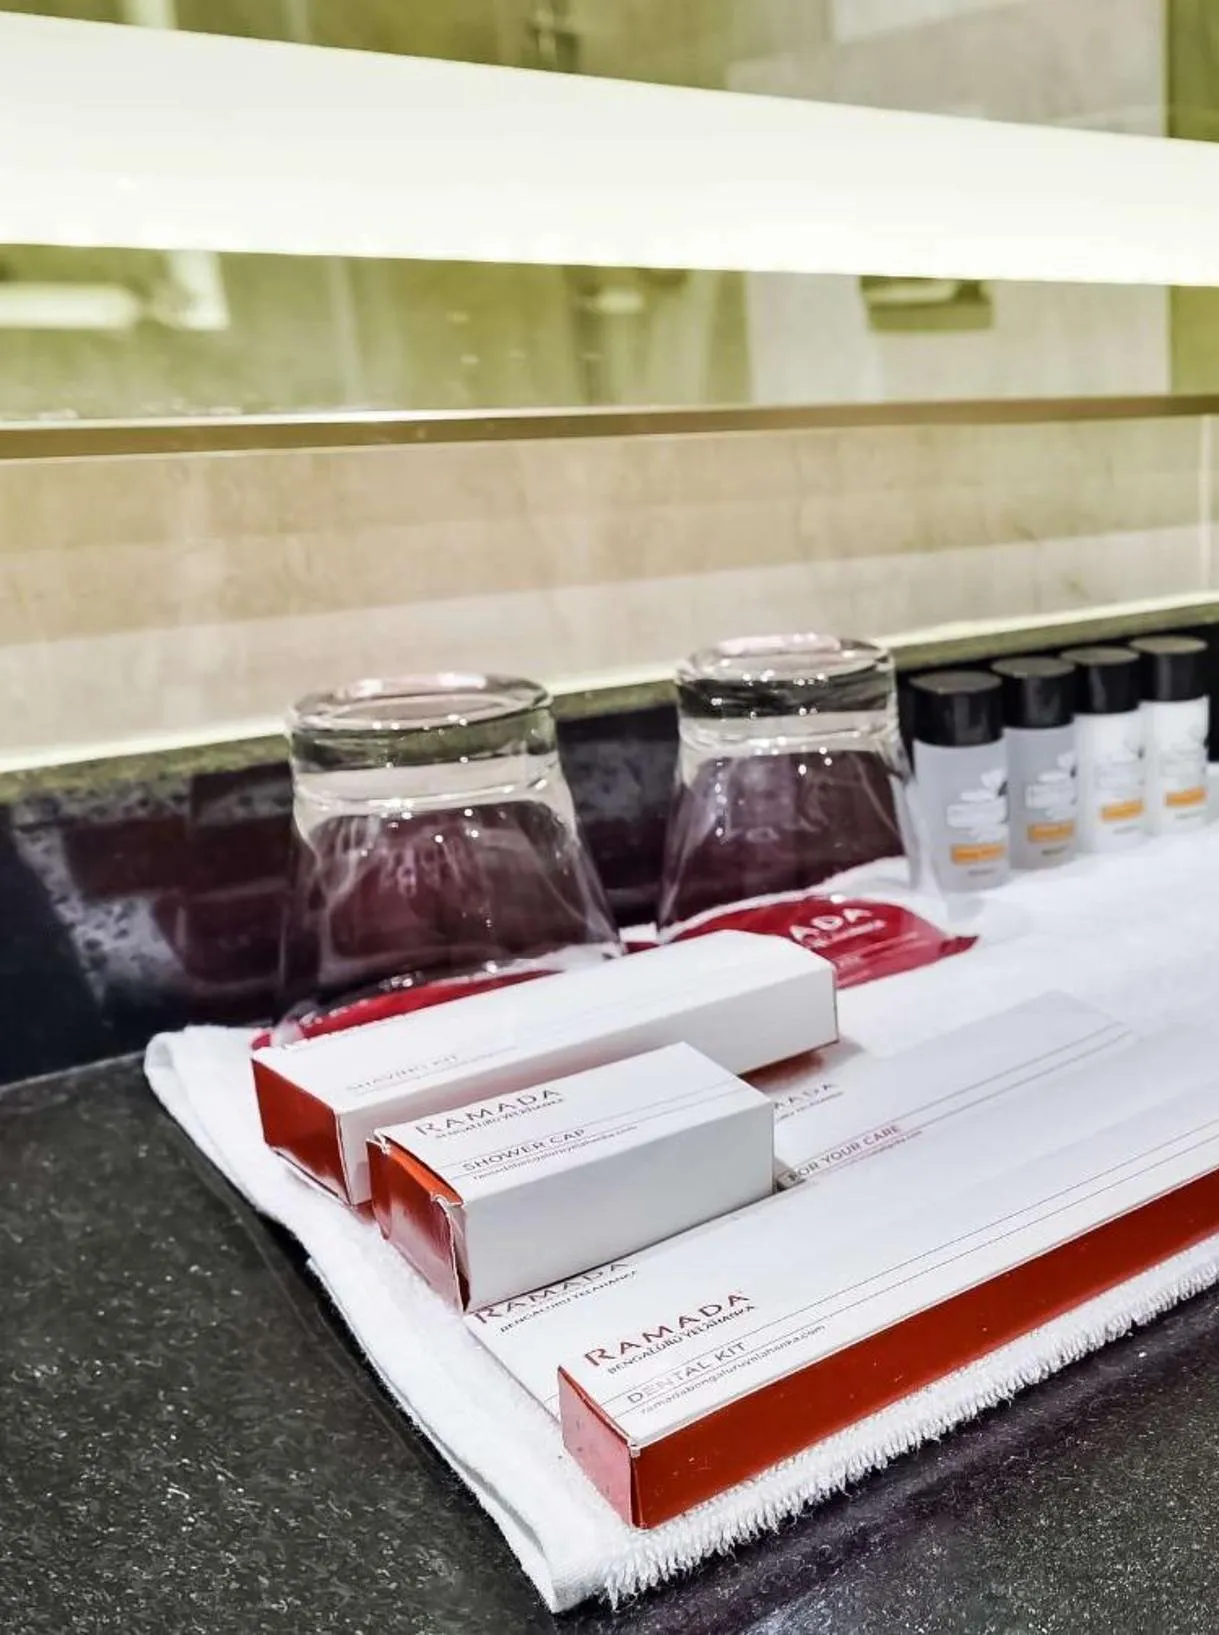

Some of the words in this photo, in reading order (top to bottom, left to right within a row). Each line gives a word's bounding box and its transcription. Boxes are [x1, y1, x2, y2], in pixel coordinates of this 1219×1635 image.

[790, 908, 873, 943] ADA
[415, 1089, 562, 1136] RAMADA
[462, 1141, 546, 1172] SHOWER
[548, 1128, 585, 1145] CAP
[821, 1141, 860, 1165] YOUR
[863, 1125, 898, 1146] CARE
[474, 1263, 629, 1324] RAMADA
[583, 1291, 751, 1368] RAMADA
[607, 1335, 684, 1376] BENGALURU
[626, 1361, 711, 1405] DENTAL
[714, 1341, 747, 1363] KIT
